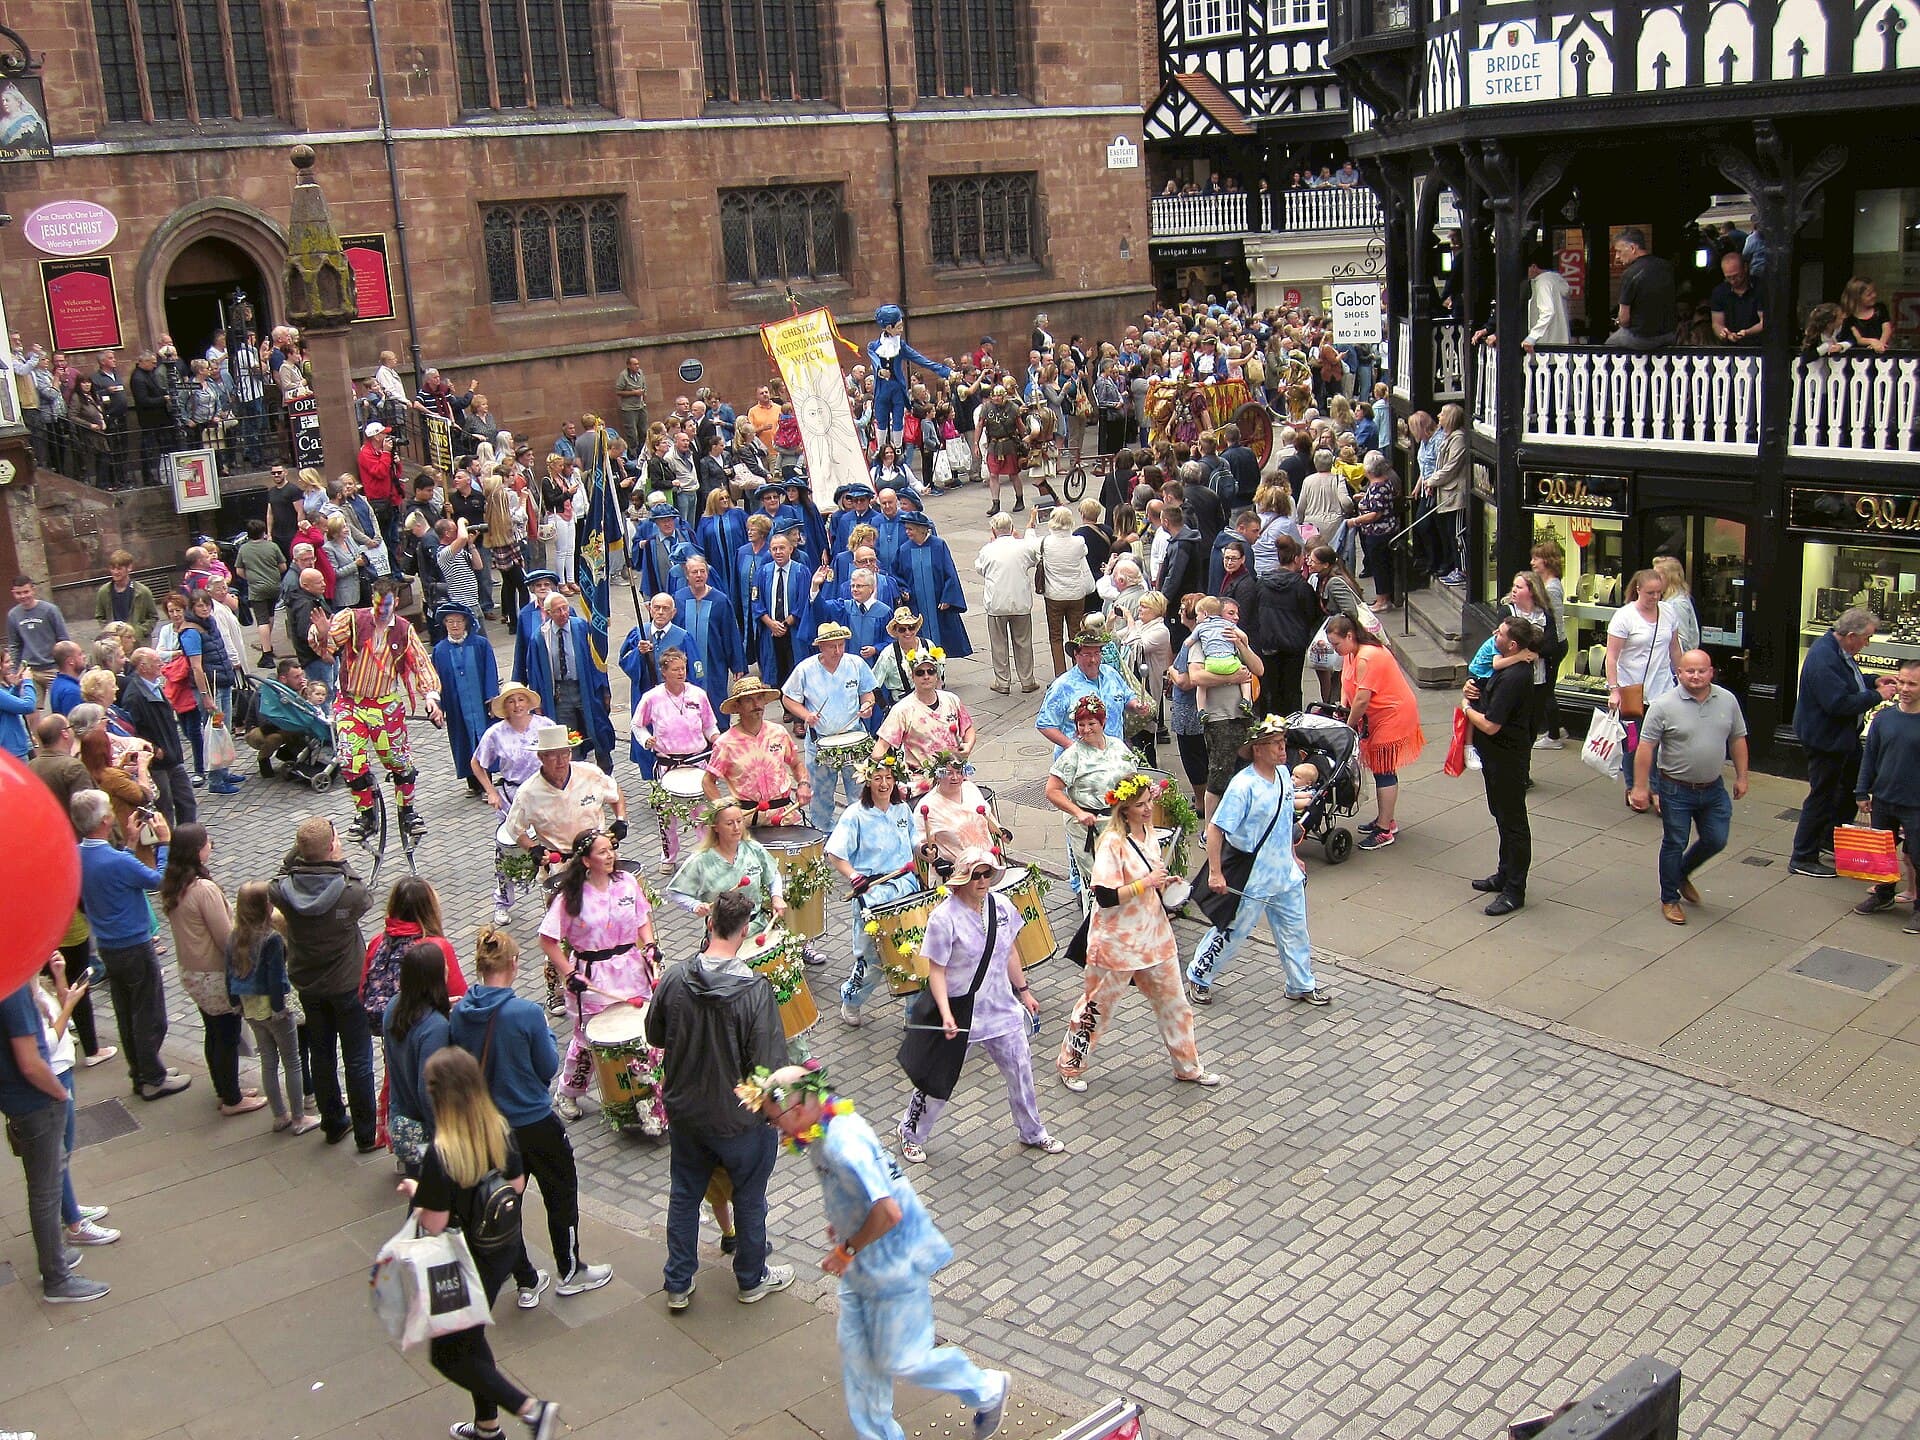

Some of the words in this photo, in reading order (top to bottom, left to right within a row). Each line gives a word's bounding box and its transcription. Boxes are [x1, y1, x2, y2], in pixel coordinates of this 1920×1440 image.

[1487, 52, 1541, 73] BRIDGE
[1486, 74, 1542, 95] STREET
[0, 149, 14, 158] The
[1109, 148, 1134, 156] EASTGATE
[1113, 157, 1132, 165] STREET
[89, 210, 104, 218] Lord
[41, 224, 68, 240] JESUS
[69, 221, 102, 236] CHRIST
[48, 239, 73, 248] Worship
[74, 238, 87, 246] Him
[1158, 248, 1188, 257] Eastgate
[1192, 247, 1207, 255] Row
[1560, 249, 1581, 296] SALE
[1335, 291, 1377, 307] Gabor
[1344, 311, 1369, 319] SHOES
[781, 322, 816, 339] CHESTER
[776, 331, 832, 356] MIDSUMMER
[790, 348, 824, 366] WATCH
[294, 399, 317, 412] OPE
[1860, 654, 1900, 666] TISSOT
[1066, 1000, 1102, 1069] KARAMBA
[435, 1276, 461, 1294] M&S
